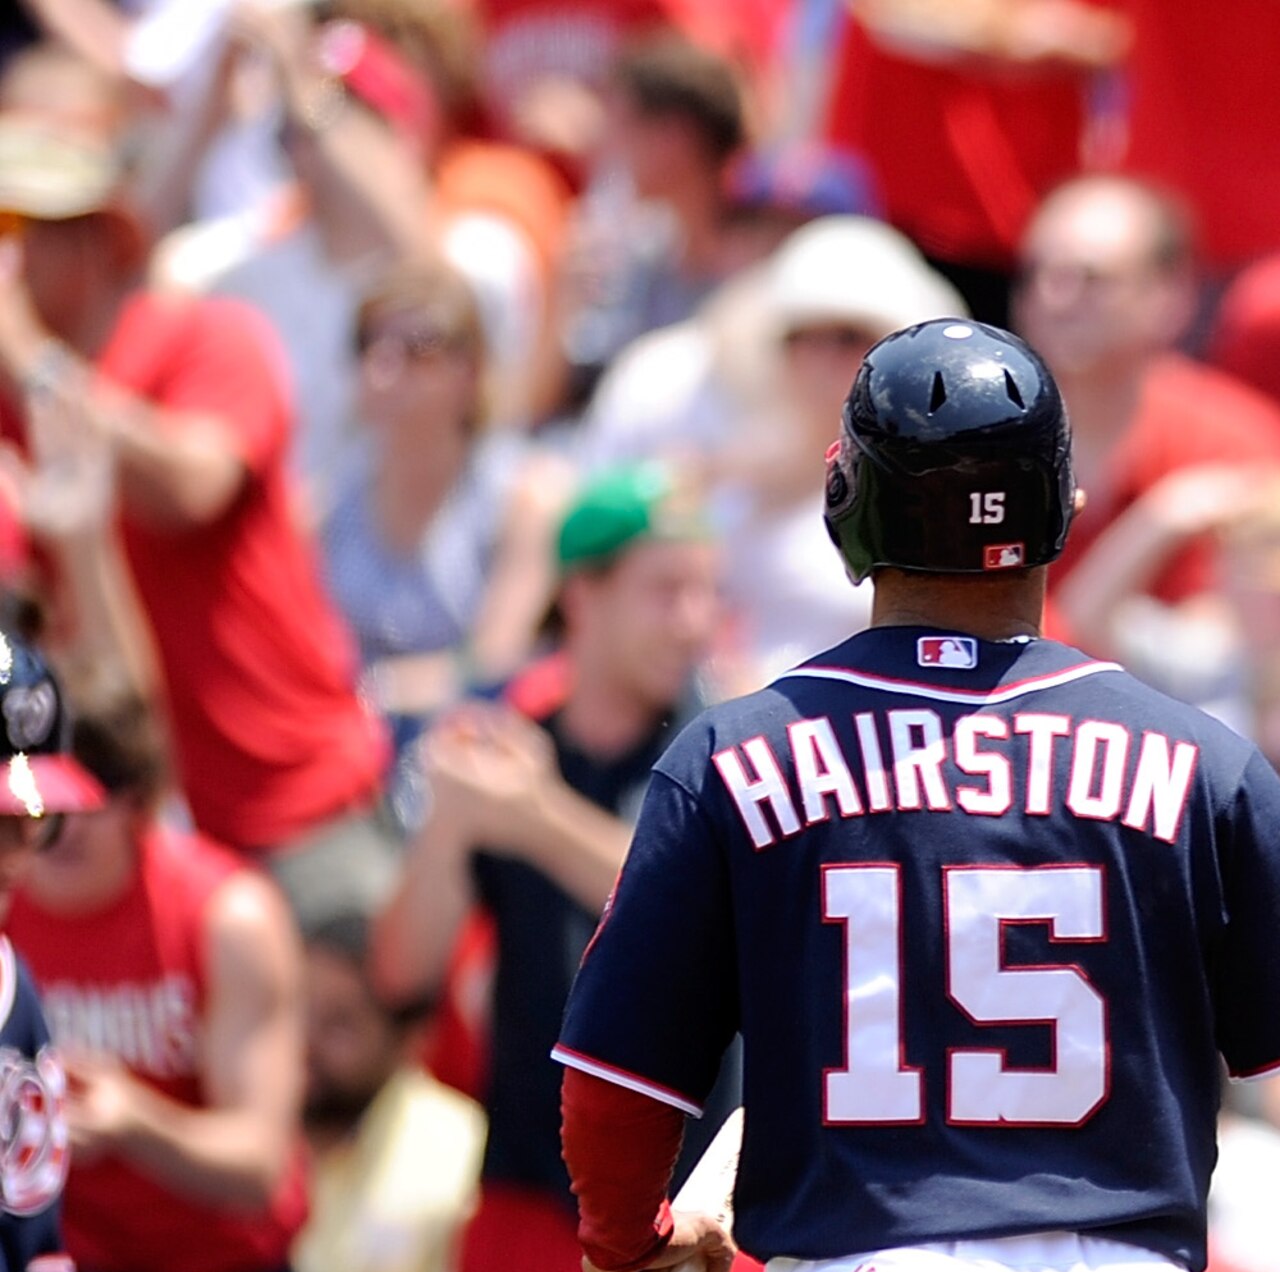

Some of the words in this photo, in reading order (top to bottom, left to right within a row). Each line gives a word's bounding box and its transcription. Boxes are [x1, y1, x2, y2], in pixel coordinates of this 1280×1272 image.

[969, 492, 1006, 524] 15
[712, 707, 1198, 852] HAIRSTON
[820, 861, 1110, 1127] 15
